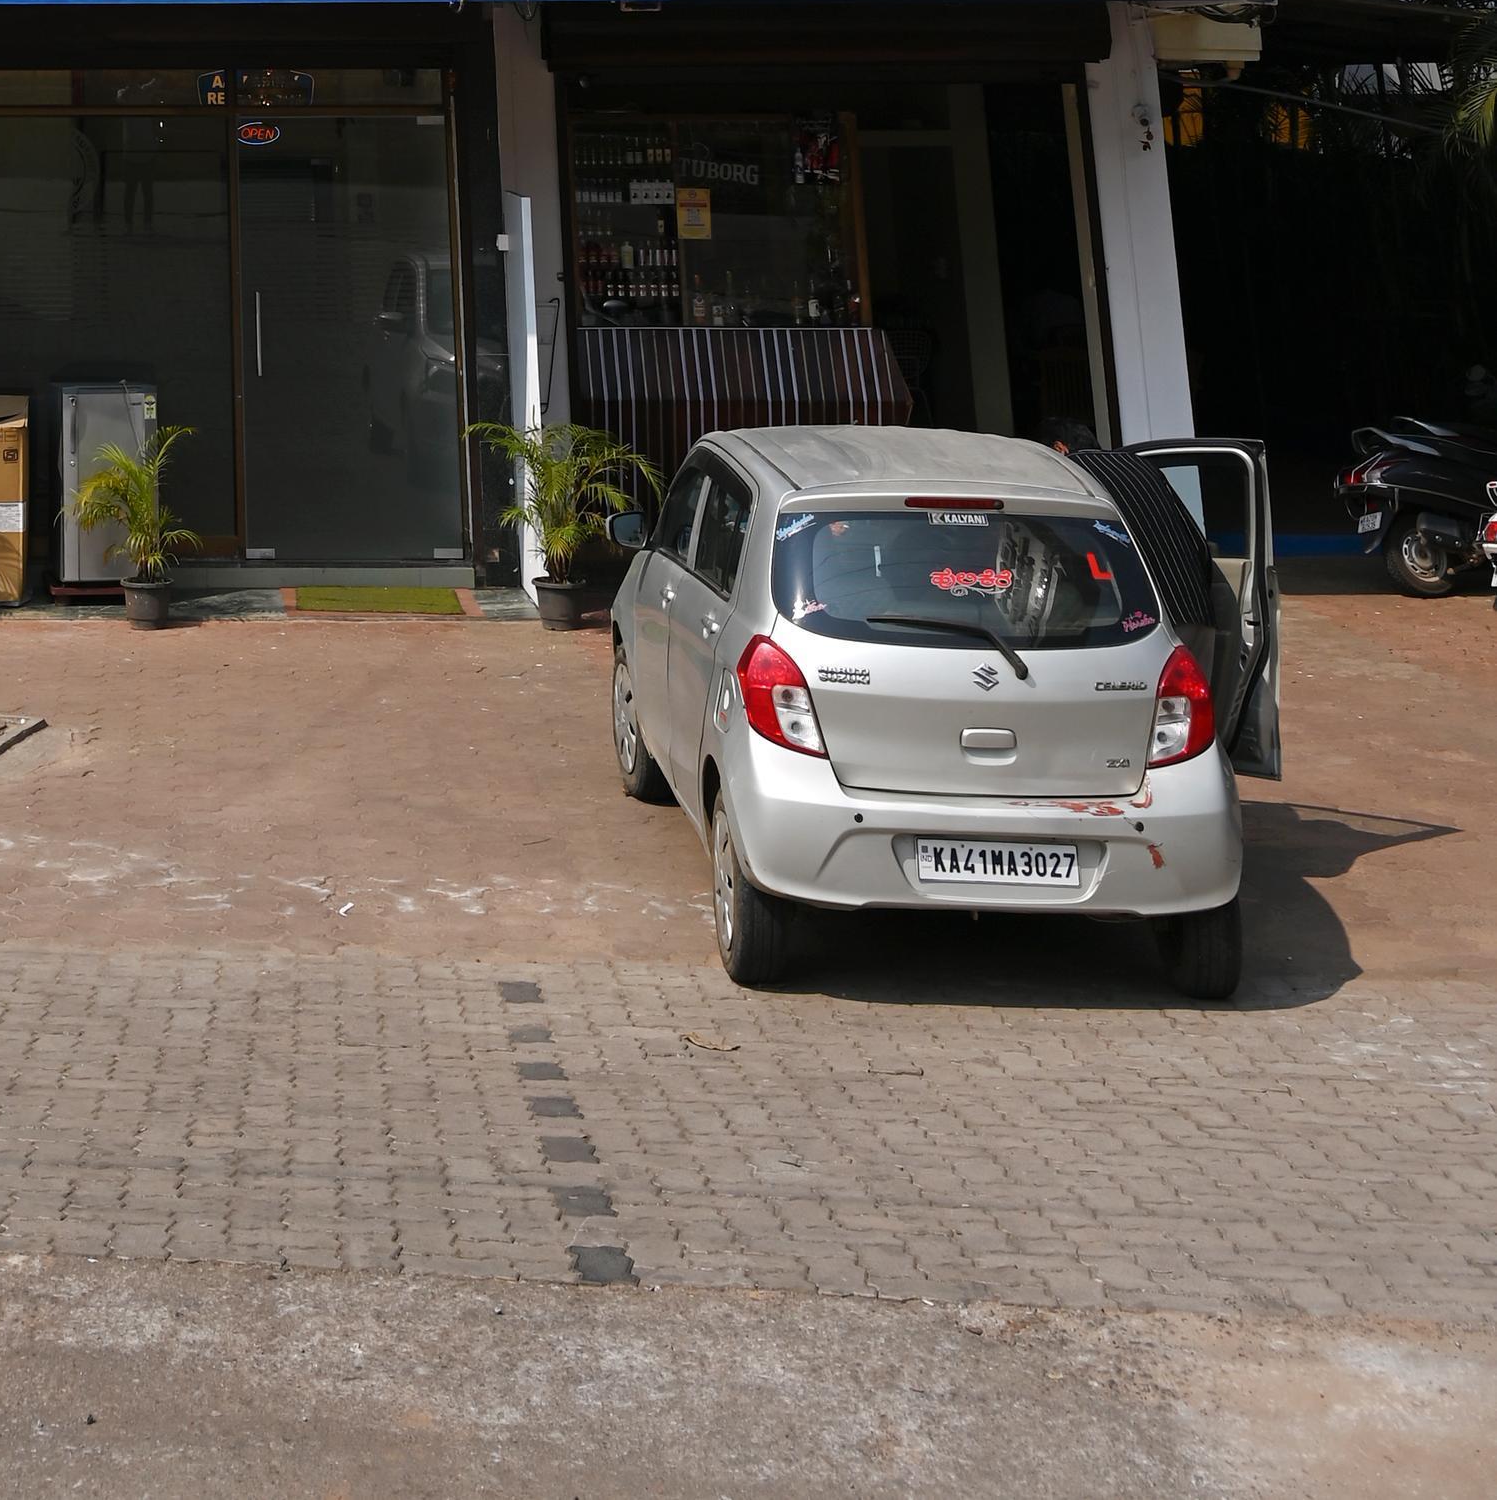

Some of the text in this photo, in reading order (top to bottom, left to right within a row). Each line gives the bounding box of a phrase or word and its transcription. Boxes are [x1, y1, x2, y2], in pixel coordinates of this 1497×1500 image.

[240, 127, 276, 140] OPEN
[678, 156, 760, 186] TUBORG
[944, 513, 986, 524] KALYANI
[818, 673, 870, 685] SUZUKI
[1094, 681, 1148, 692] CELERIO
[933, 846, 1076, 879] KA41MA3027
